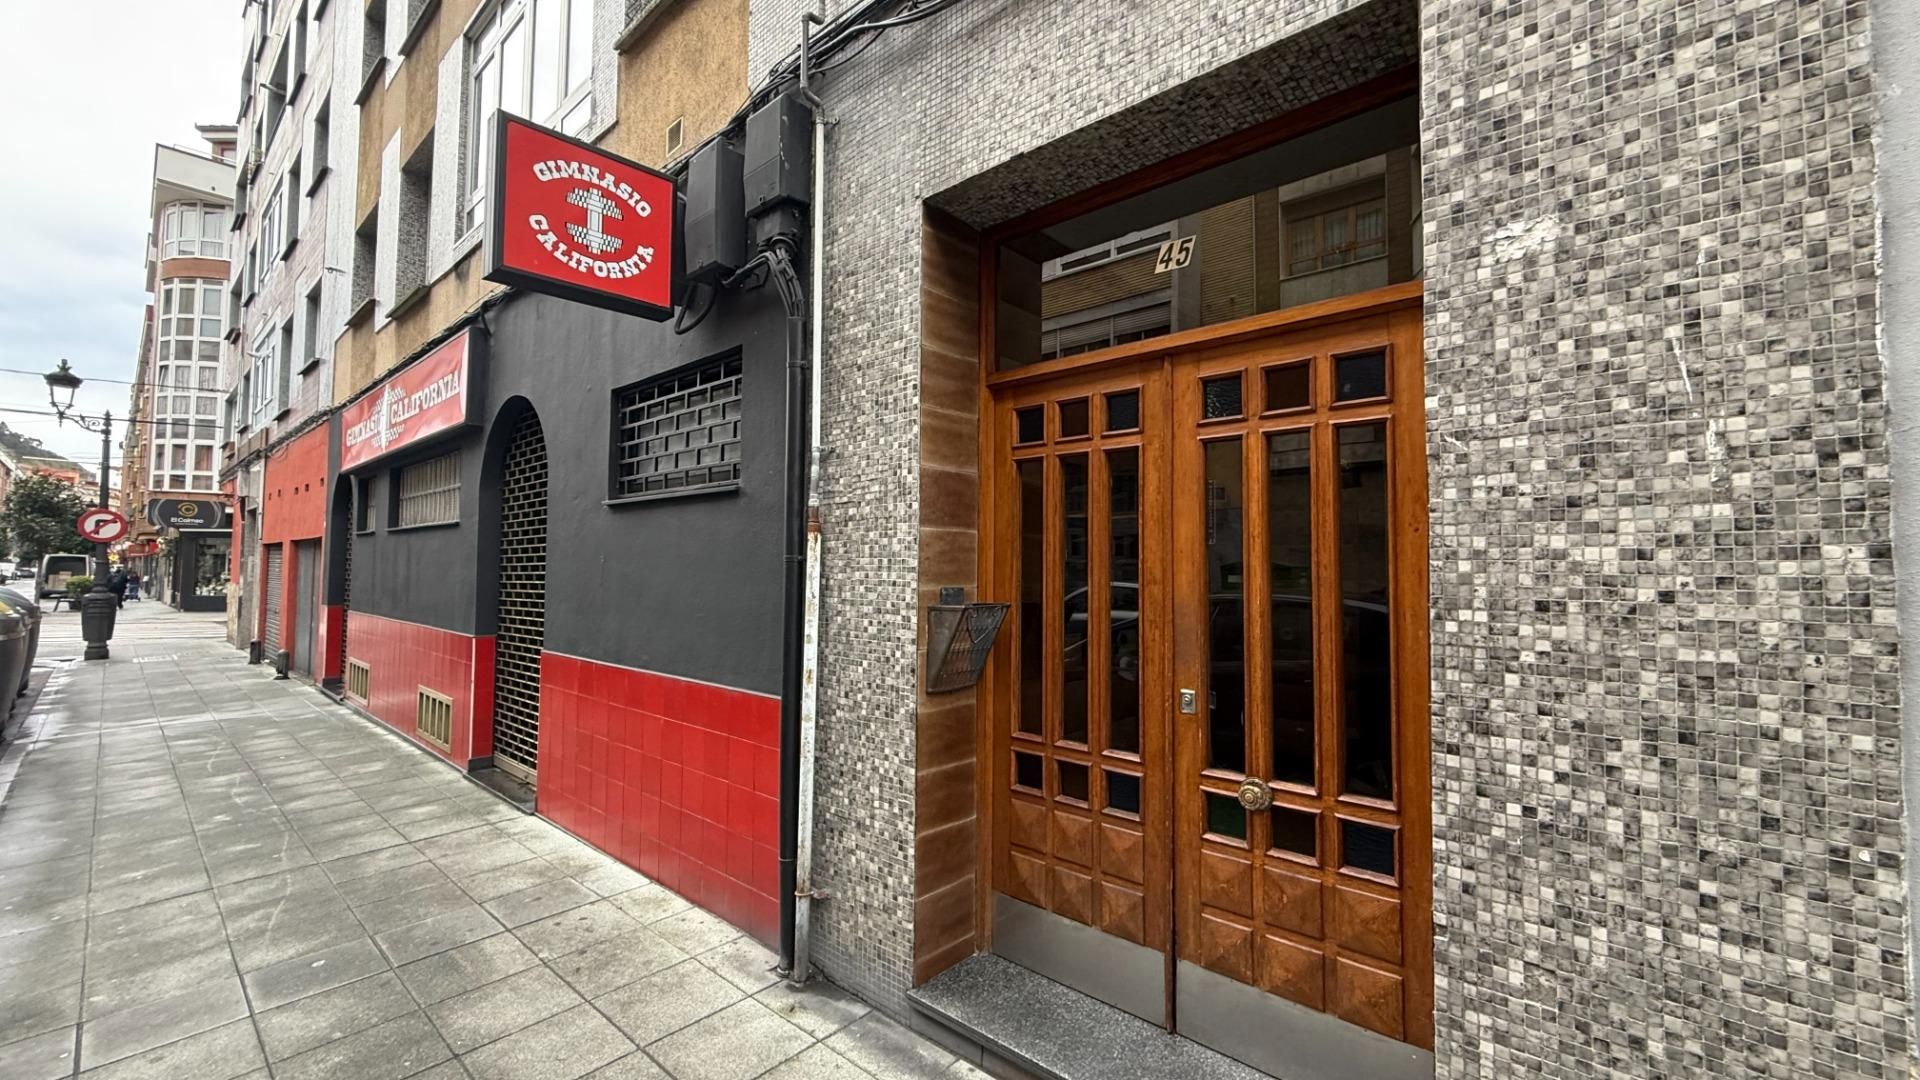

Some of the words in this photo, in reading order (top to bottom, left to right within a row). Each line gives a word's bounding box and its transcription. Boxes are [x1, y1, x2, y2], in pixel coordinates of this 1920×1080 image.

[533, 160, 652, 218] GIMNASIO
[529, 214, 655, 279] CALIFORNIA
[1159, 237, 1193, 269] 45
[391, 370, 460, 425] CALIFORNIA
